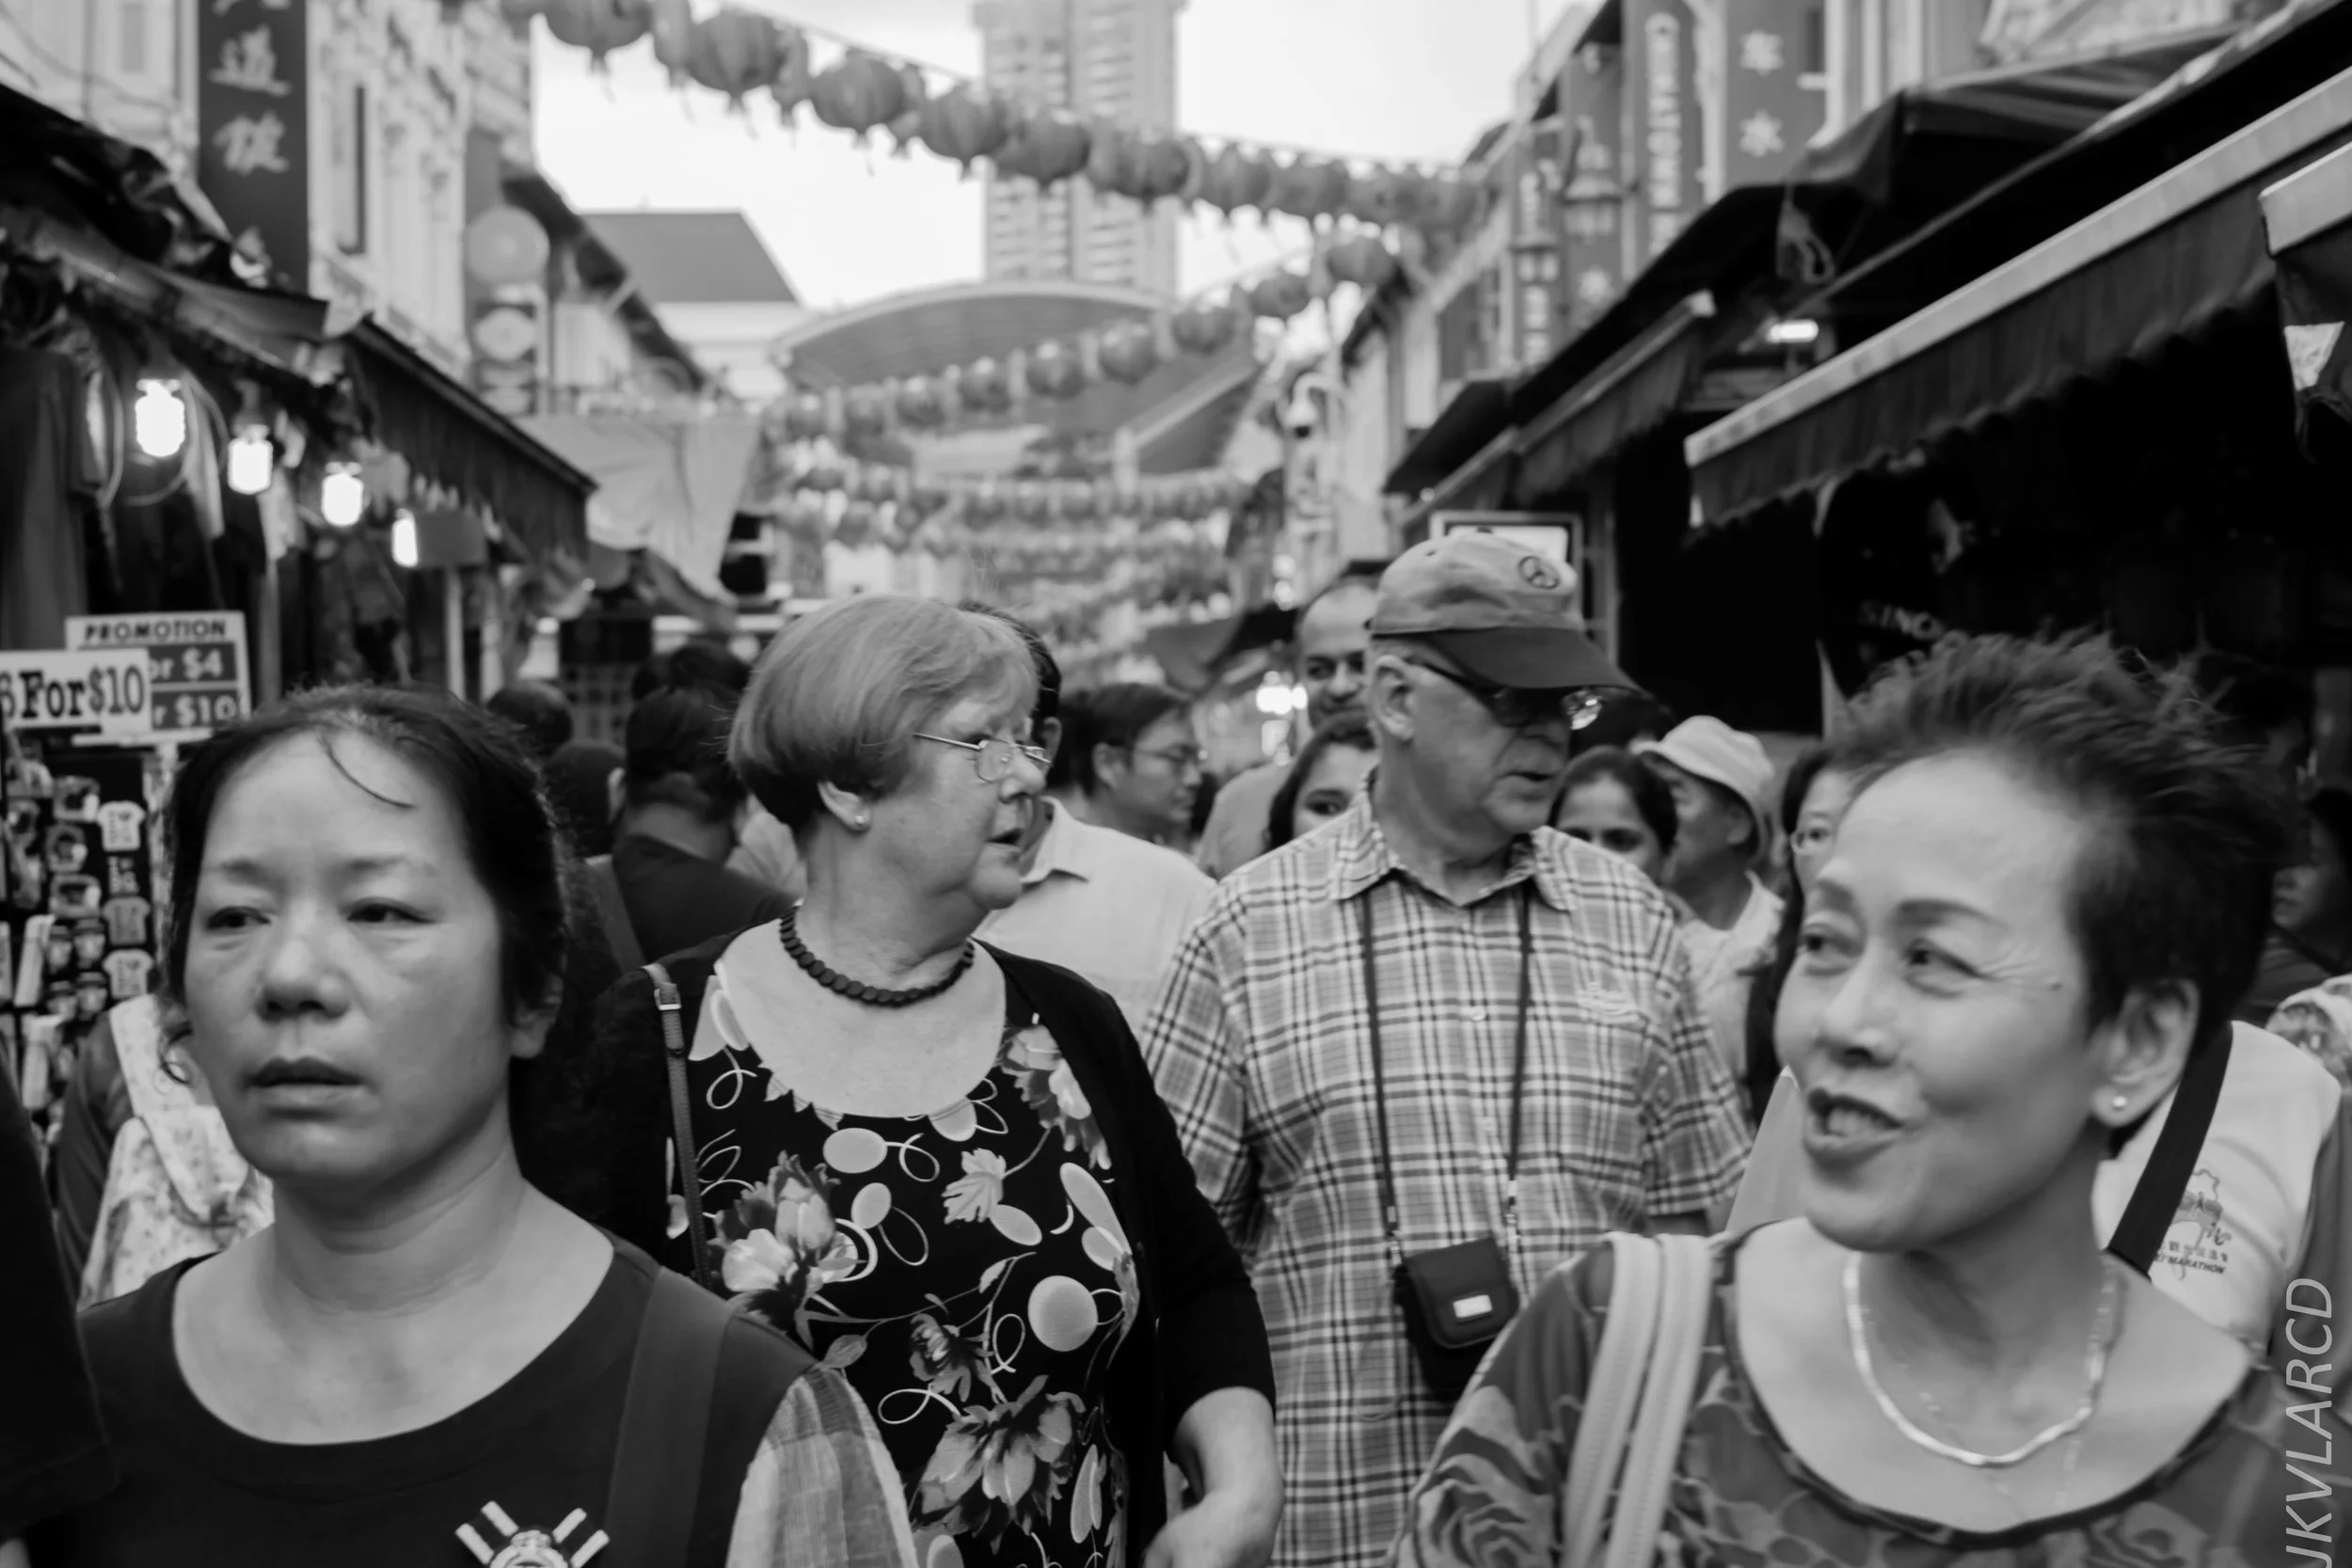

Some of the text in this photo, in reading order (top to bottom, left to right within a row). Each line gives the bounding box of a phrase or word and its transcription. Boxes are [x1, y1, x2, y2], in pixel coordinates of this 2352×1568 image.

[87, 621, 227, 641] PROMOTION
[183, 647, 224, 679] $4
[176, 696, 236, 728] $10
[2169, 1256, 2225, 1274] MARATHON
